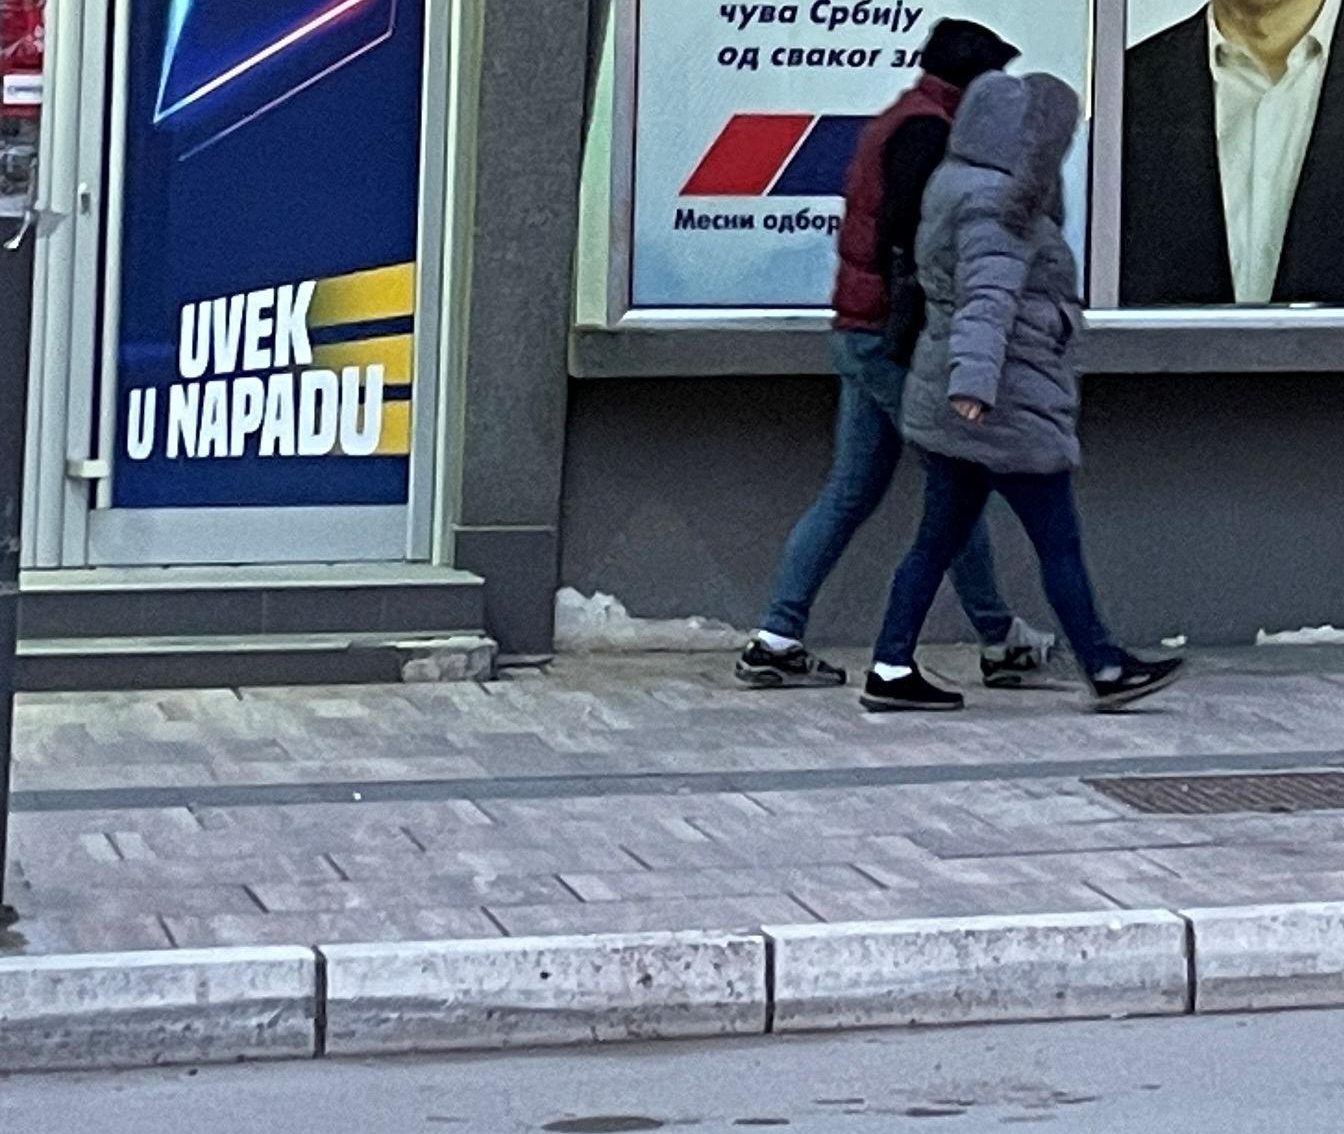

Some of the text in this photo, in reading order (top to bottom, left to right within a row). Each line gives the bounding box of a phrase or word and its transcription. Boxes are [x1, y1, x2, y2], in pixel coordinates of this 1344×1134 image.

[719, 4, 798, 30] чува
[717, 45, 923, 71] од сваког зл
[673, 207, 841, 235] Месни одбор
[179, 279, 317, 379] UVEK
[125, 362, 386, 461] U NAPADU
